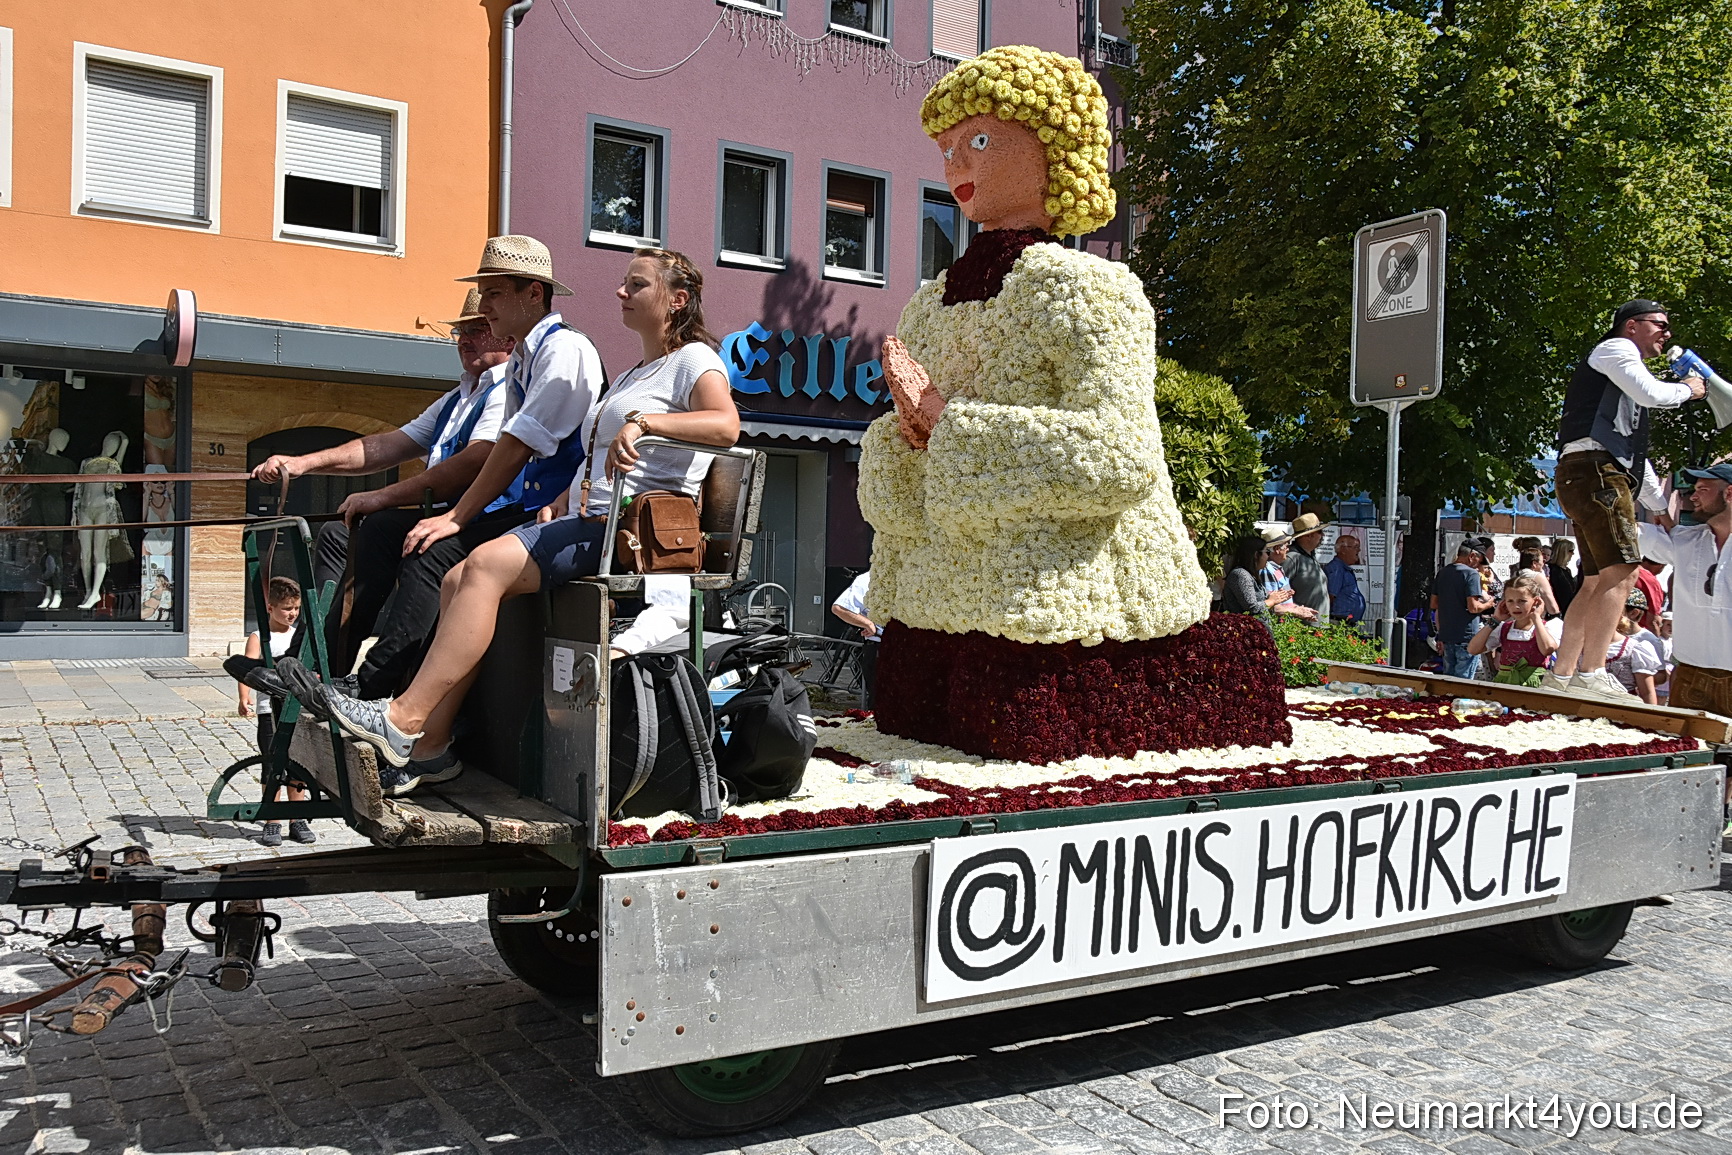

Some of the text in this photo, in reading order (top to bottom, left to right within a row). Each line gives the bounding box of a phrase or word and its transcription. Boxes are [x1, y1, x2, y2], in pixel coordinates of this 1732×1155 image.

[1381, 295, 1413, 313] ZONE
[718, 320, 893, 406] Eille
[208, 442, 225, 457] 30
[1497, 567, 1510, 577] neu
[937, 784, 1571, 981] @MINIS.HOFKIRCHE
